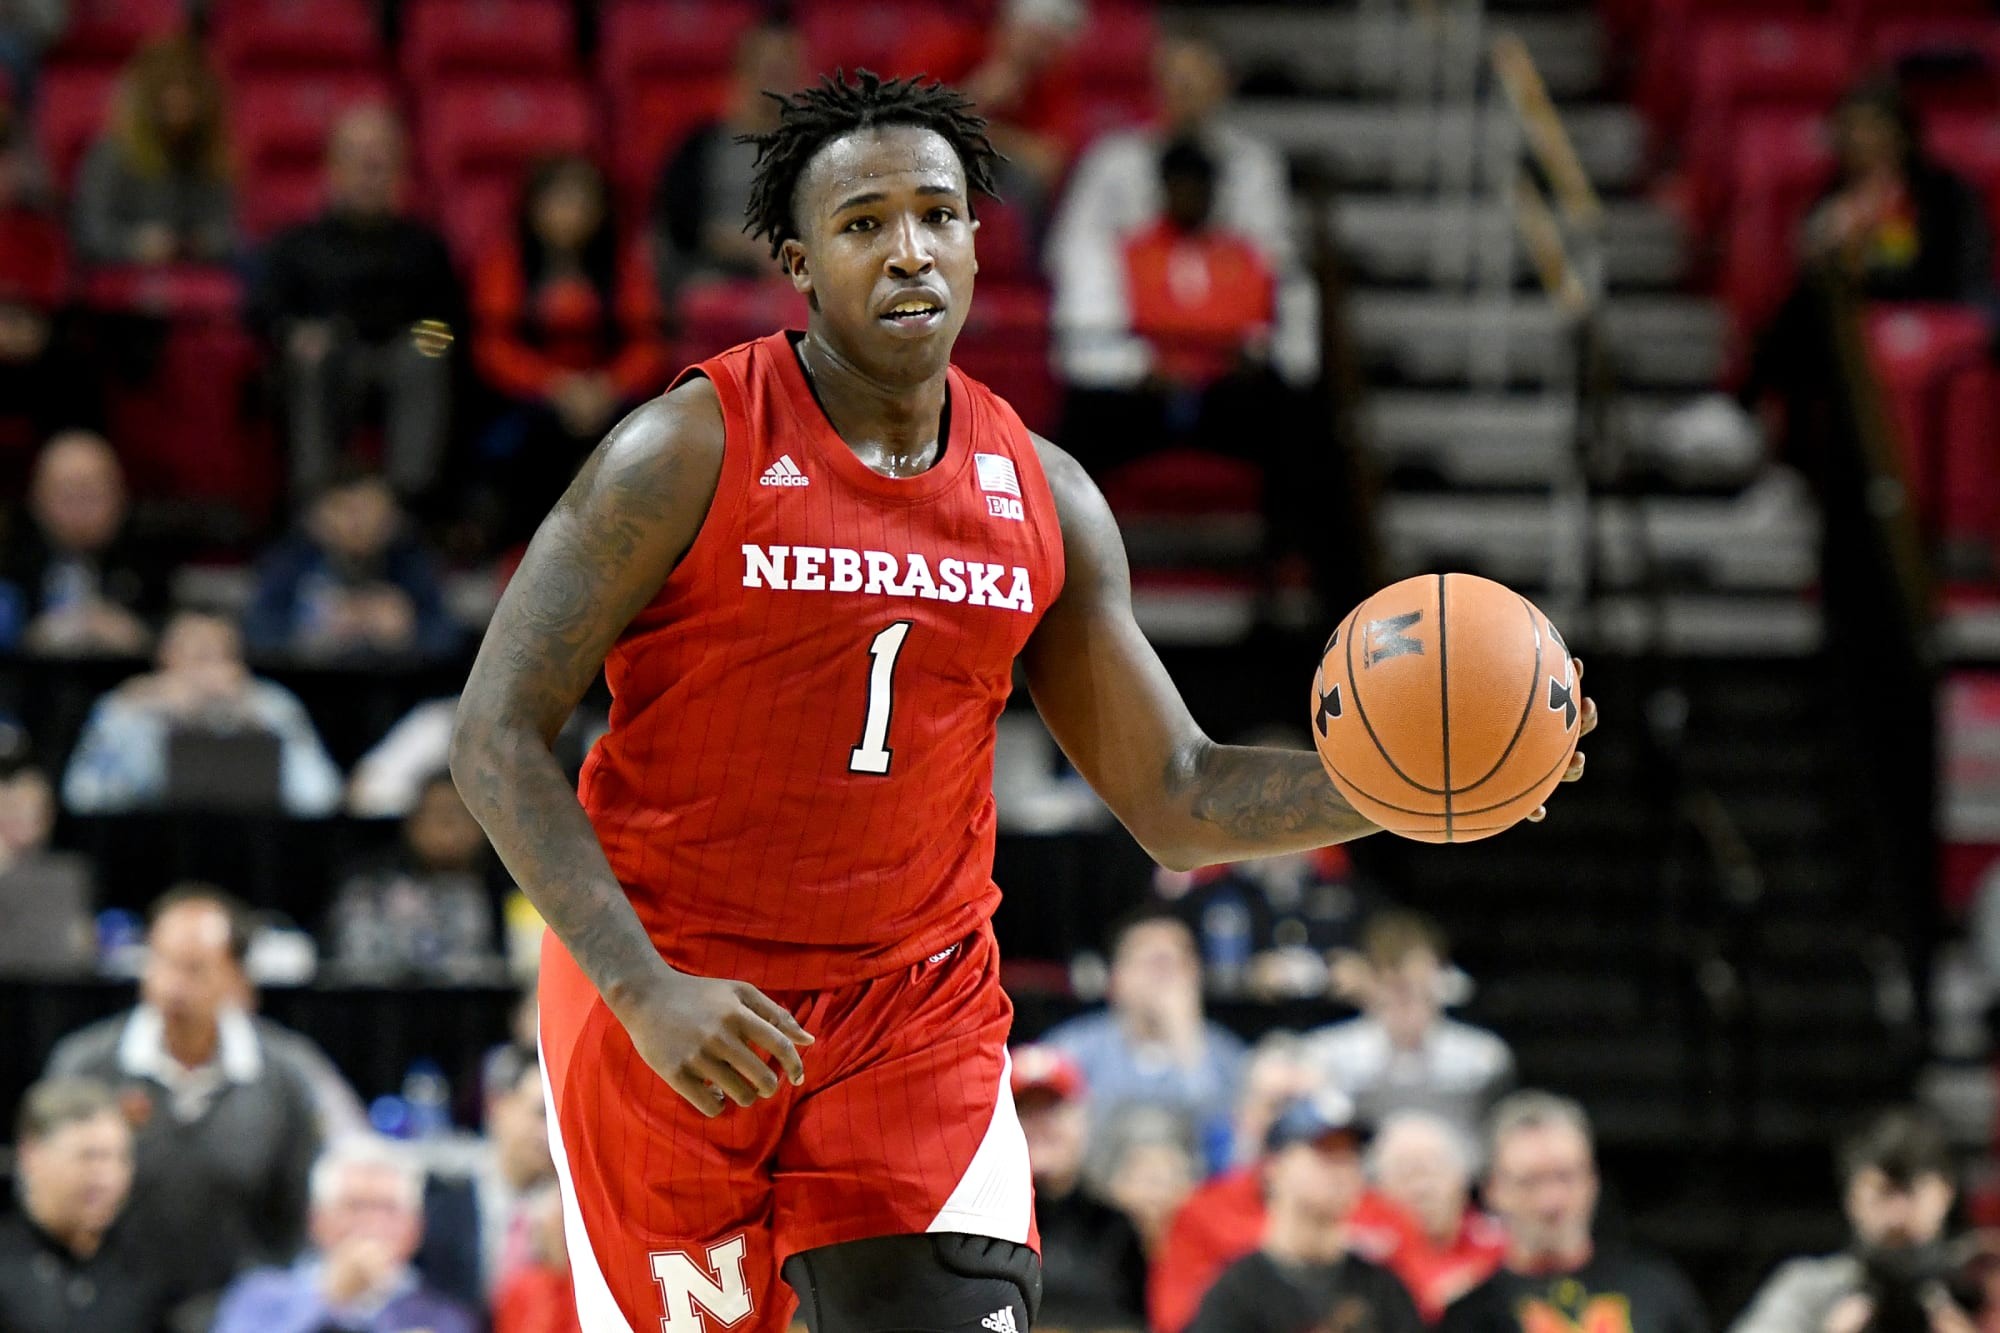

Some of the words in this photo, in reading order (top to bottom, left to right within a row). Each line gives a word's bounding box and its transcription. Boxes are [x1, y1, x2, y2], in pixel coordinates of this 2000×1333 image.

[760, 474, 809, 487] adidas
[742, 544, 1034, 613] NEBRASKA
[848, 619, 914, 776] 1
[648, 1233, 755, 1333] N
